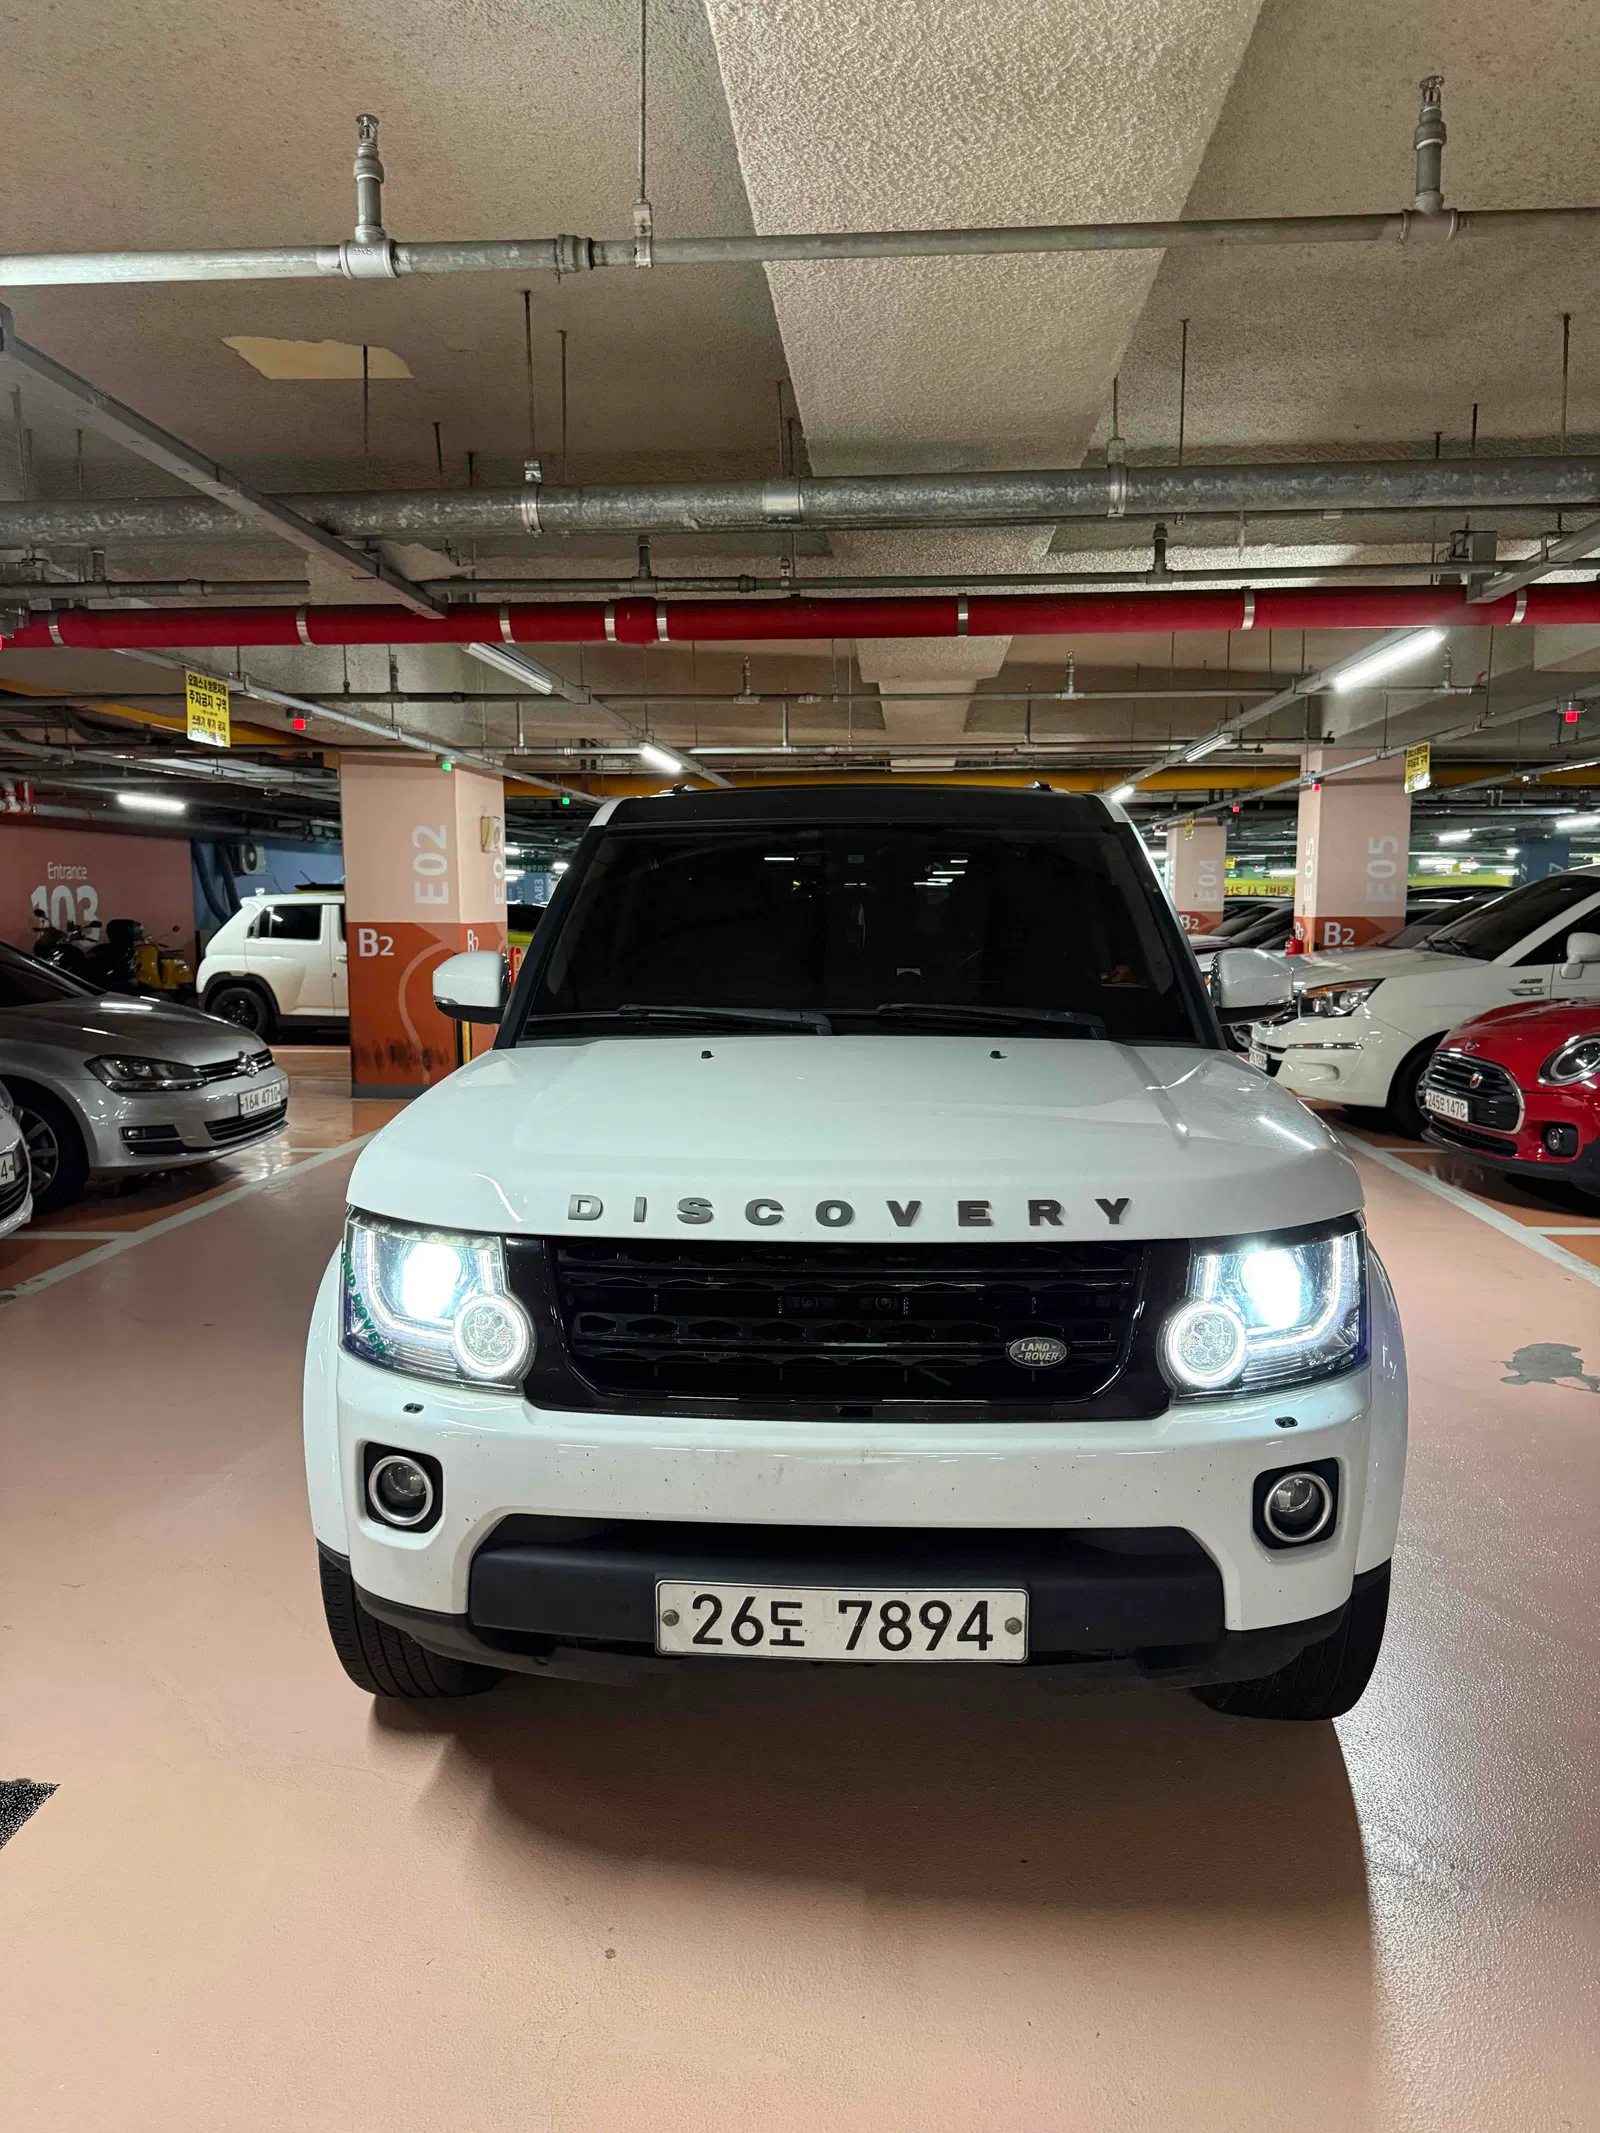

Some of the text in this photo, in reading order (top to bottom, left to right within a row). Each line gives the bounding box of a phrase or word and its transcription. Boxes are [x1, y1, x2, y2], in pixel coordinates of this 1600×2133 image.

[189, 689, 214, 709] 주차금지
[216, 697, 227, 713] 구역
[47, 861, 88, 880] Entrance
[412, 824, 449, 904] E02
[1303, 836, 1315, 902] E05
[1366, 835, 1398, 902] E05
[534, 878, 545, 901] A83
[1199, 859, 1219, 902] E04
[31, 885, 100, 947] 103
[1179, 914, 1199, 931] B2
[358, 928, 395, 957] B2
[1324, 921, 1355, 946] B2
[567, 1193, 1132, 1227] DISCOVERY
[1021, 1342, 1050, 1351] LAND
[1024, 1352, 1059, 1360] ROVER
[692, 1593, 994, 1652] 26도 7894
